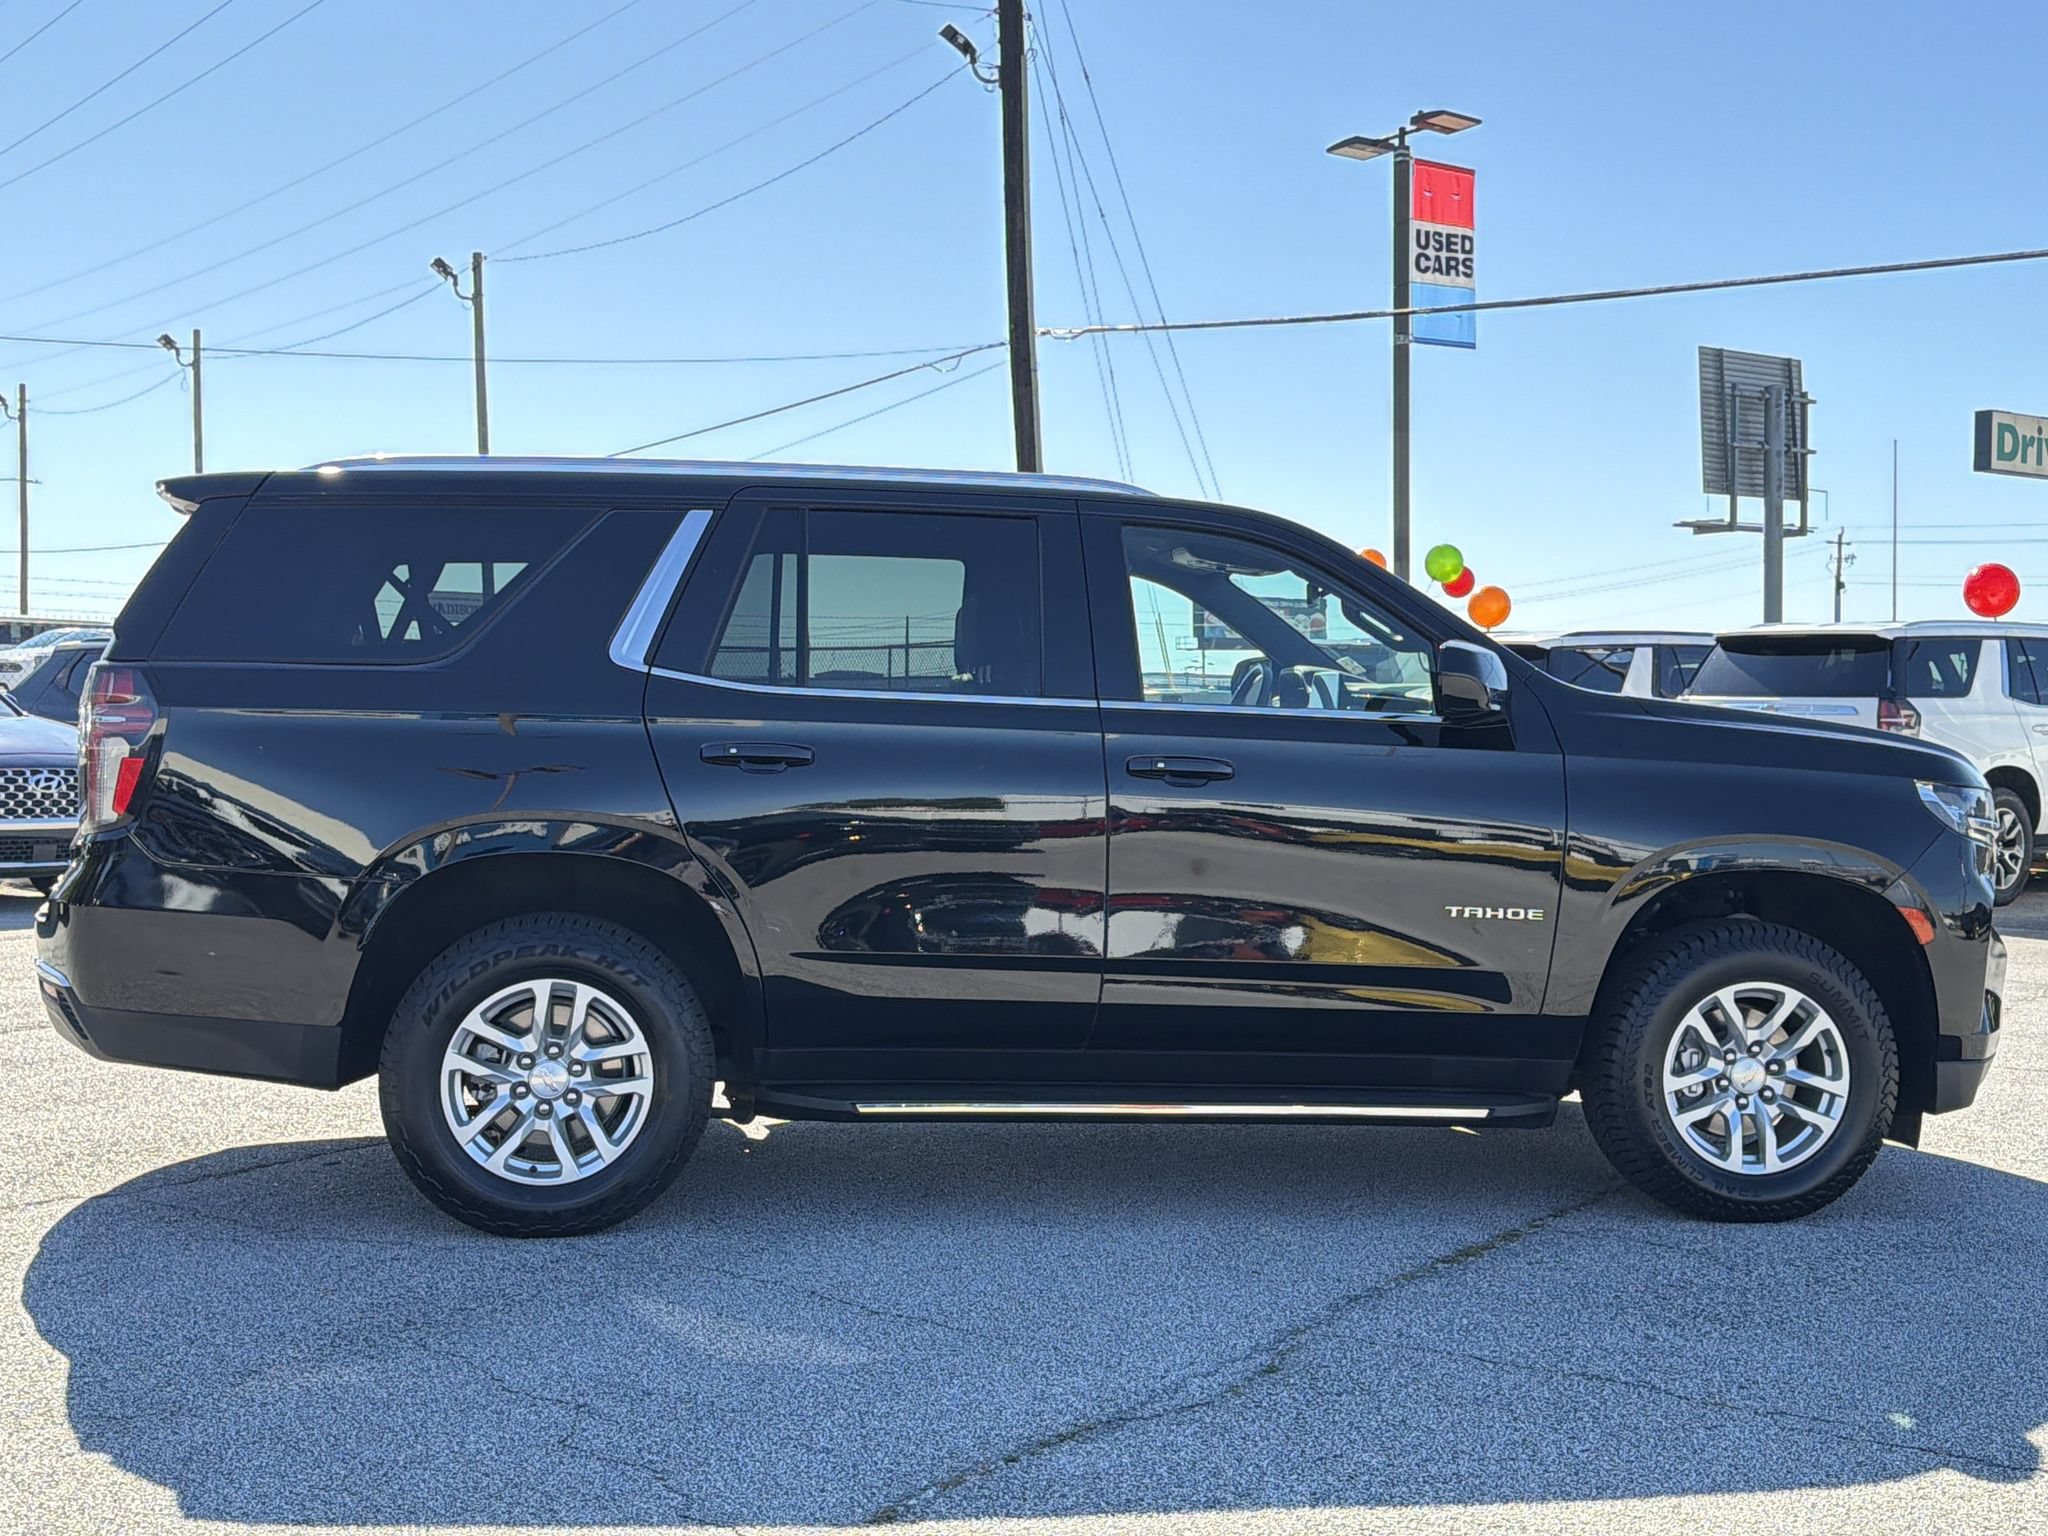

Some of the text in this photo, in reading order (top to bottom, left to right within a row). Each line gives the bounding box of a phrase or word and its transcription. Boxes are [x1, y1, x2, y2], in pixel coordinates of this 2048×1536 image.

[1415, 228, 1474, 254] USED
[1414, 253, 1474, 278] CARS
[1444, 905, 1545, 921] TAHOE
[421, 943, 581, 1029] WILDPEAK
[1807, 972, 1870, 1041] SUMMIT
